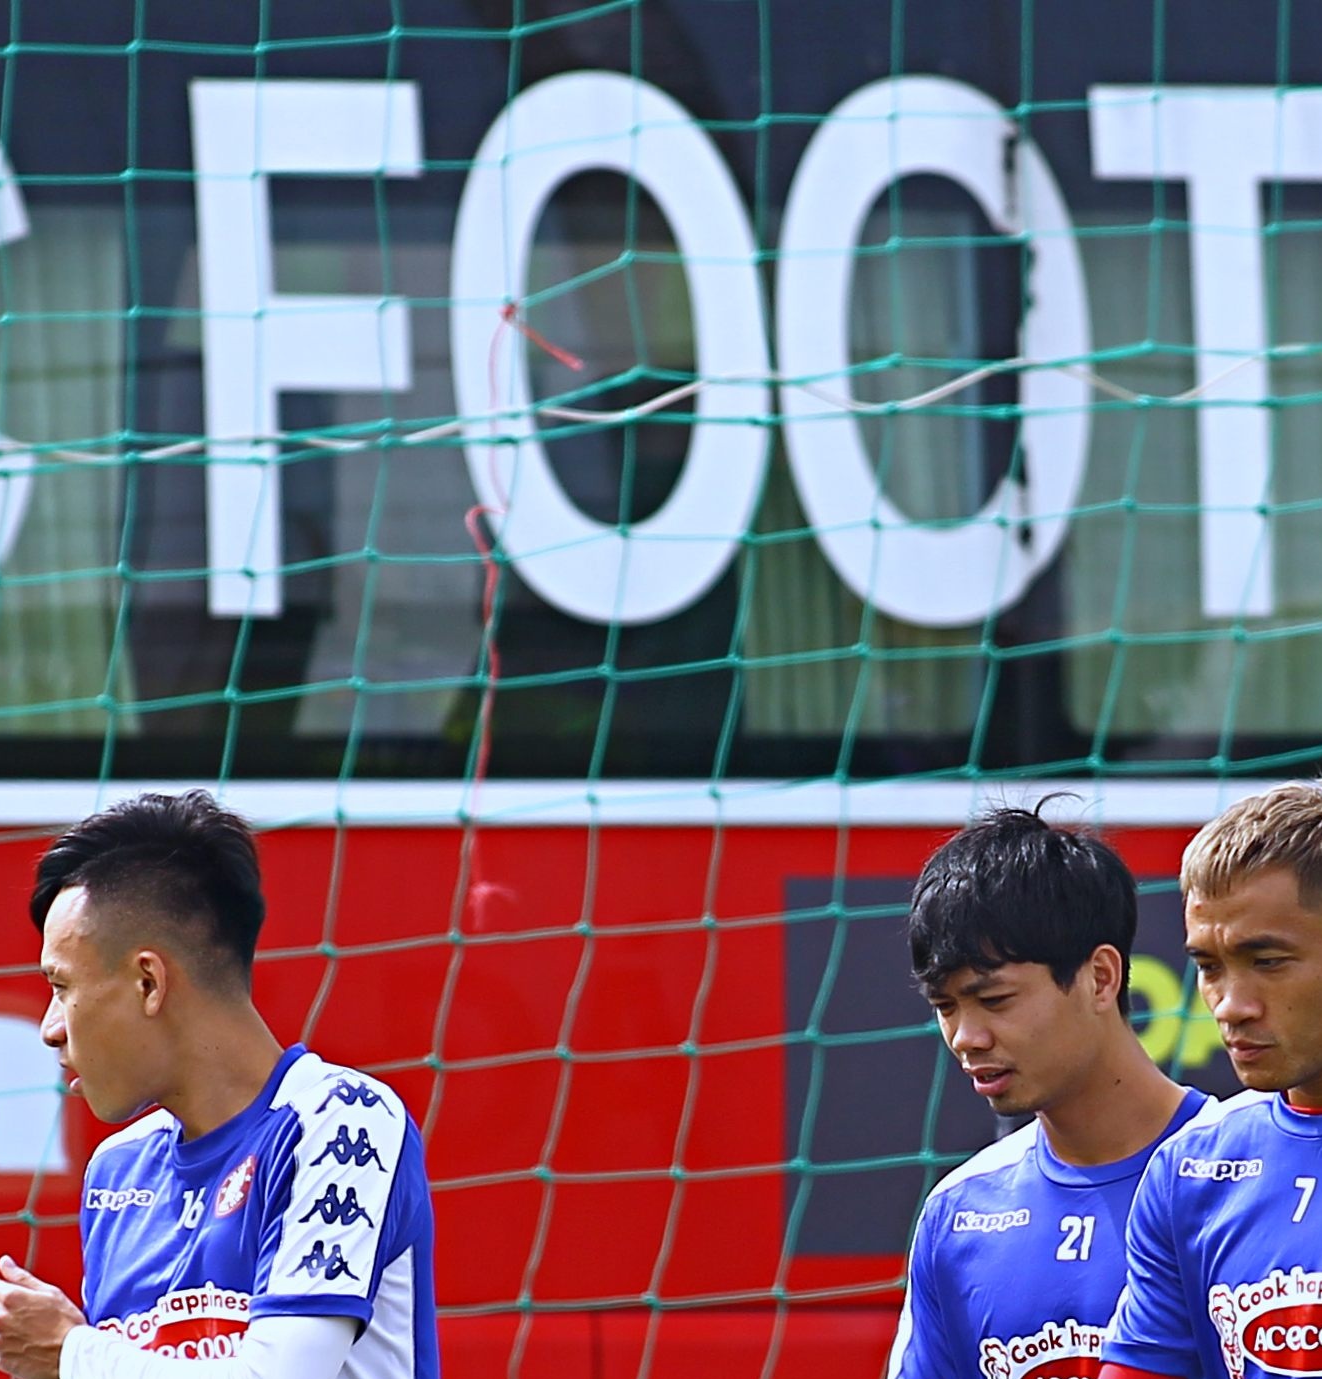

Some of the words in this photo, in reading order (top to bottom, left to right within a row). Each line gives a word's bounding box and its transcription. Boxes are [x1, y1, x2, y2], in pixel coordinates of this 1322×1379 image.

[1178, 1157, 1264, 1182] Kappa
[86, 1187, 155, 1211] Kappa
[178, 1187, 205, 1230] 16
[1291, 1176, 1317, 1224] 7
[953, 1209, 1030, 1233] Kappa
[1056, 1215, 1095, 1261] 21
[1237, 1276, 1289, 1313] Cook
[1011, 1328, 1064, 1364] Cook
